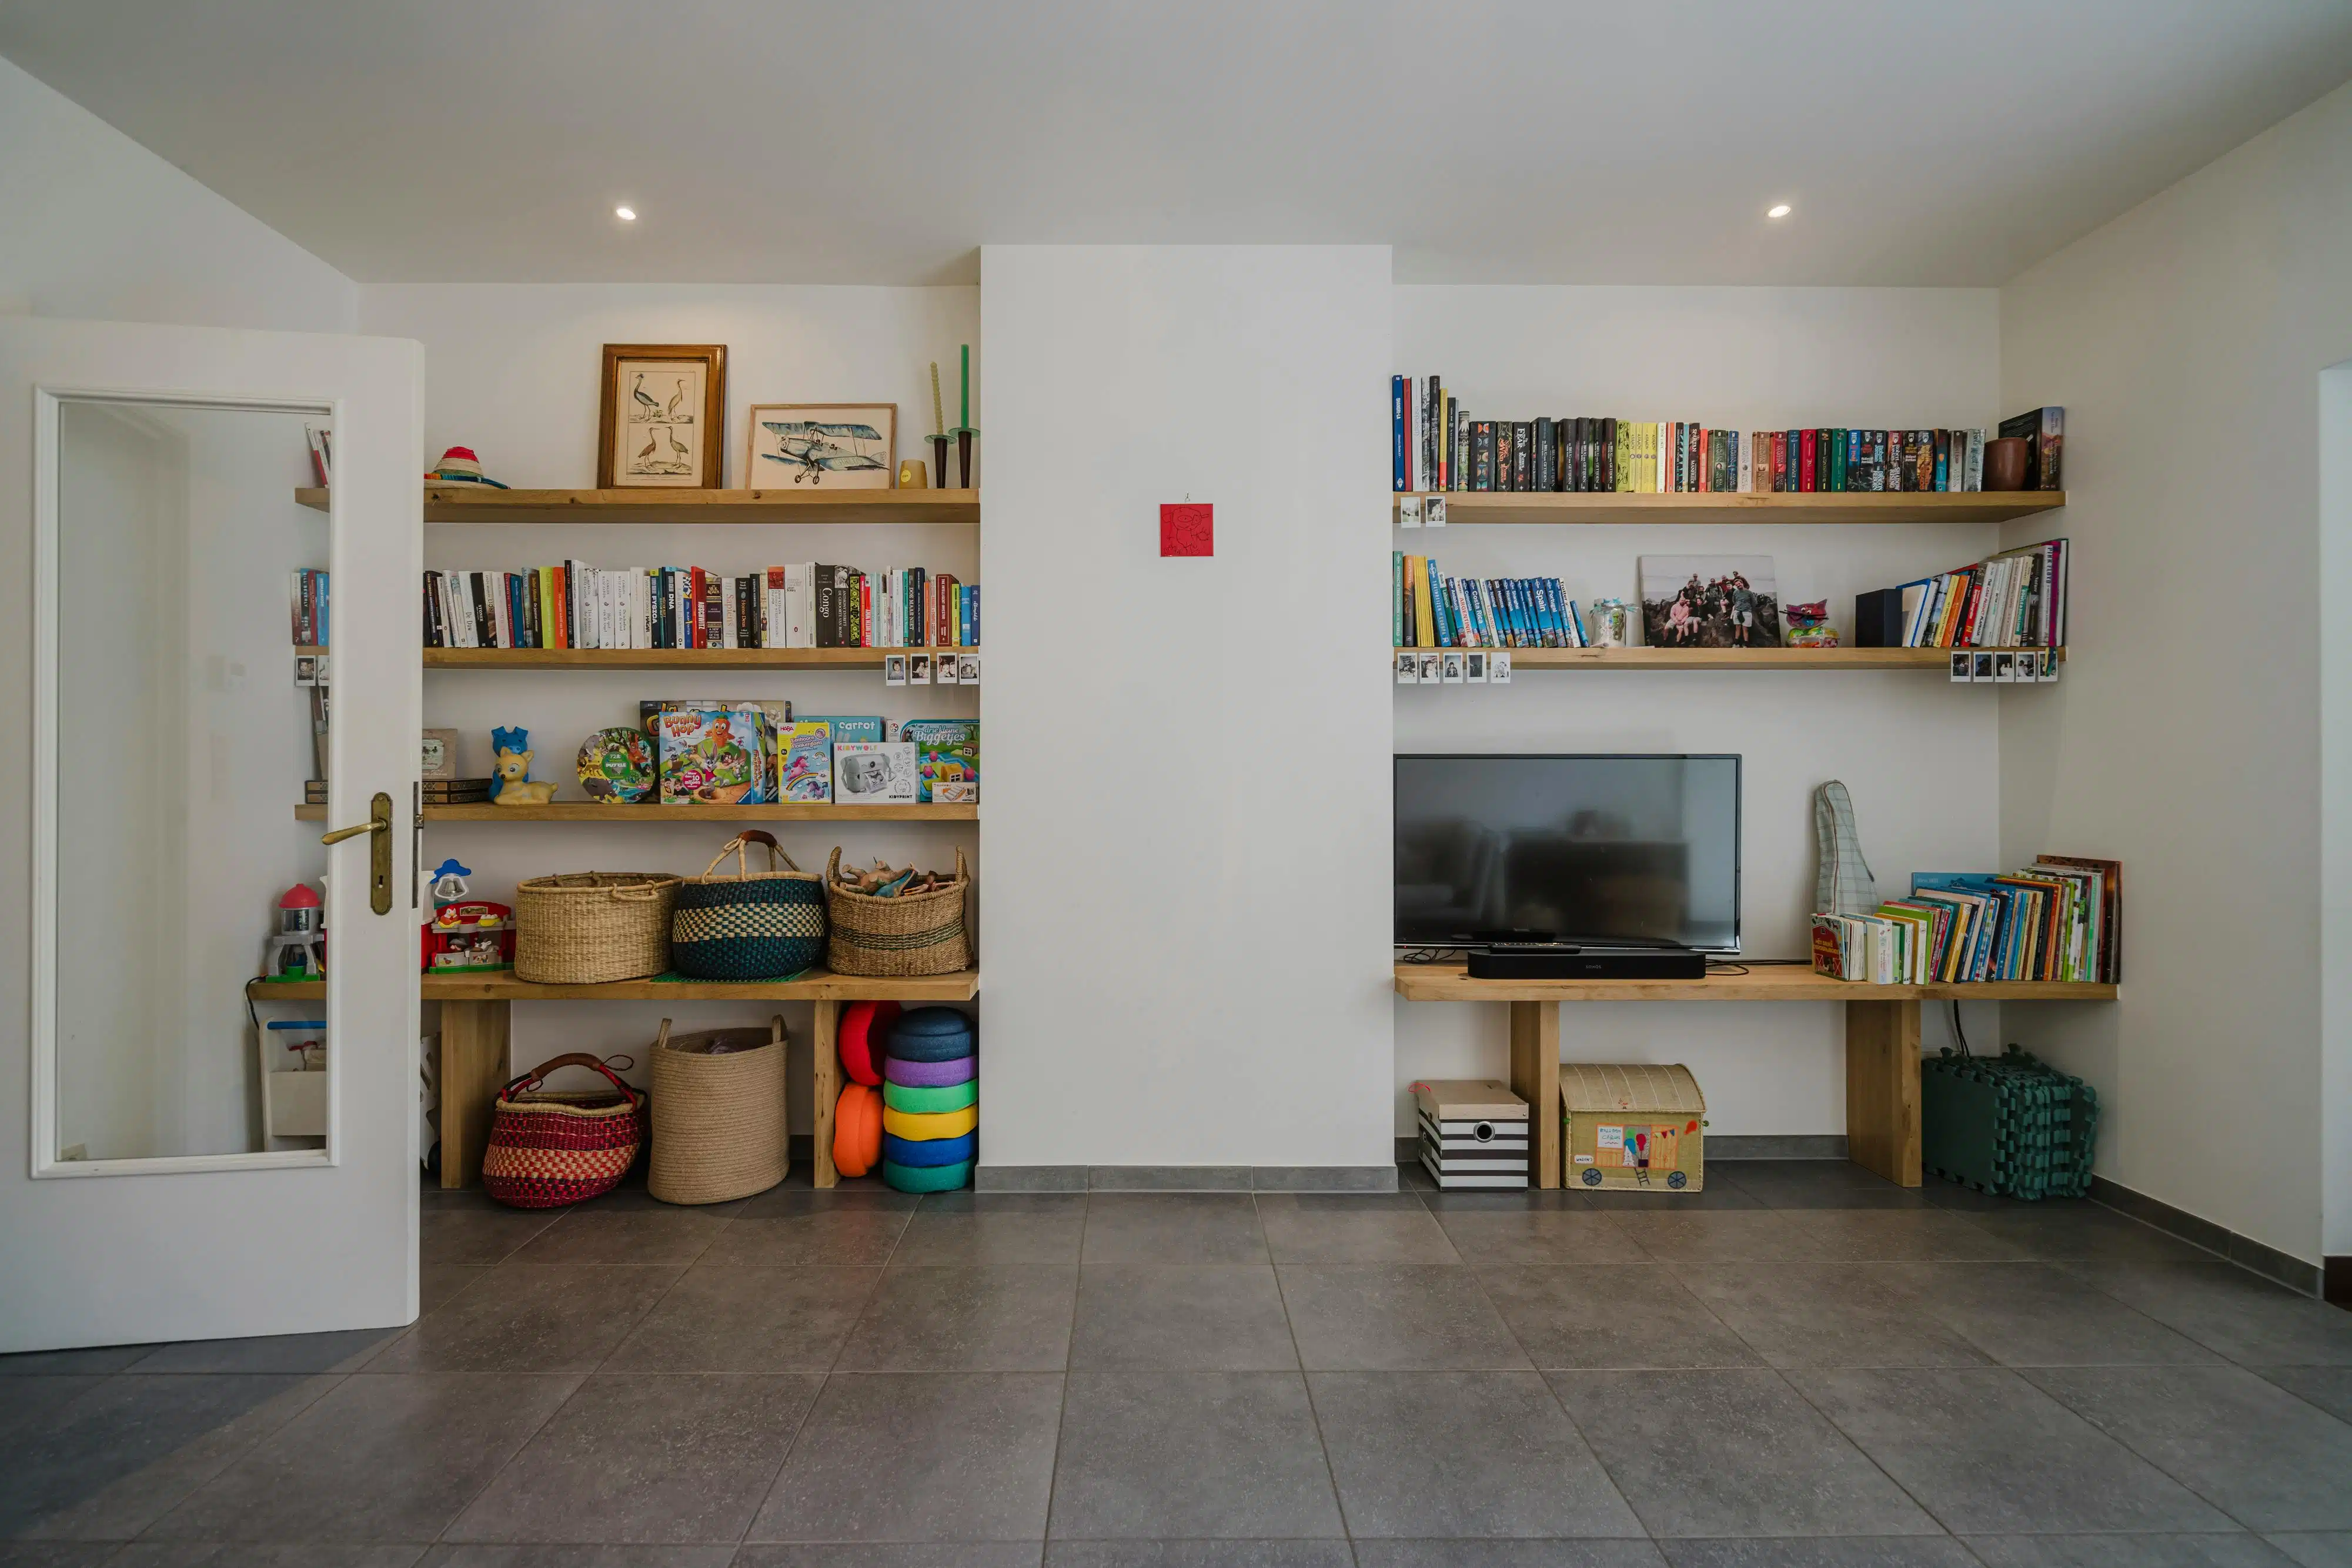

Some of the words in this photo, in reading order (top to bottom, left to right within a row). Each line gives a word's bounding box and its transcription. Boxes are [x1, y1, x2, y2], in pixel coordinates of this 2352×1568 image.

[1517, 428, 1525, 448] FEAR
[819, 587, 832, 618] Congo
[1472, 591, 1480, 609] Costa
[1536, 589, 1546, 612] Spain
[1548, 590, 1558, 613] Portugal
[724, 594, 734, 626] Sapiens
[663, 714, 701, 729] Bunny
[671, 723, 695, 737] Hop
[924, 725, 938, 733] drie
[938, 725, 959, 734] kleine
[790, 735, 815, 744] Eenhoorn
[914, 730, 965, 745] Biggetjes
